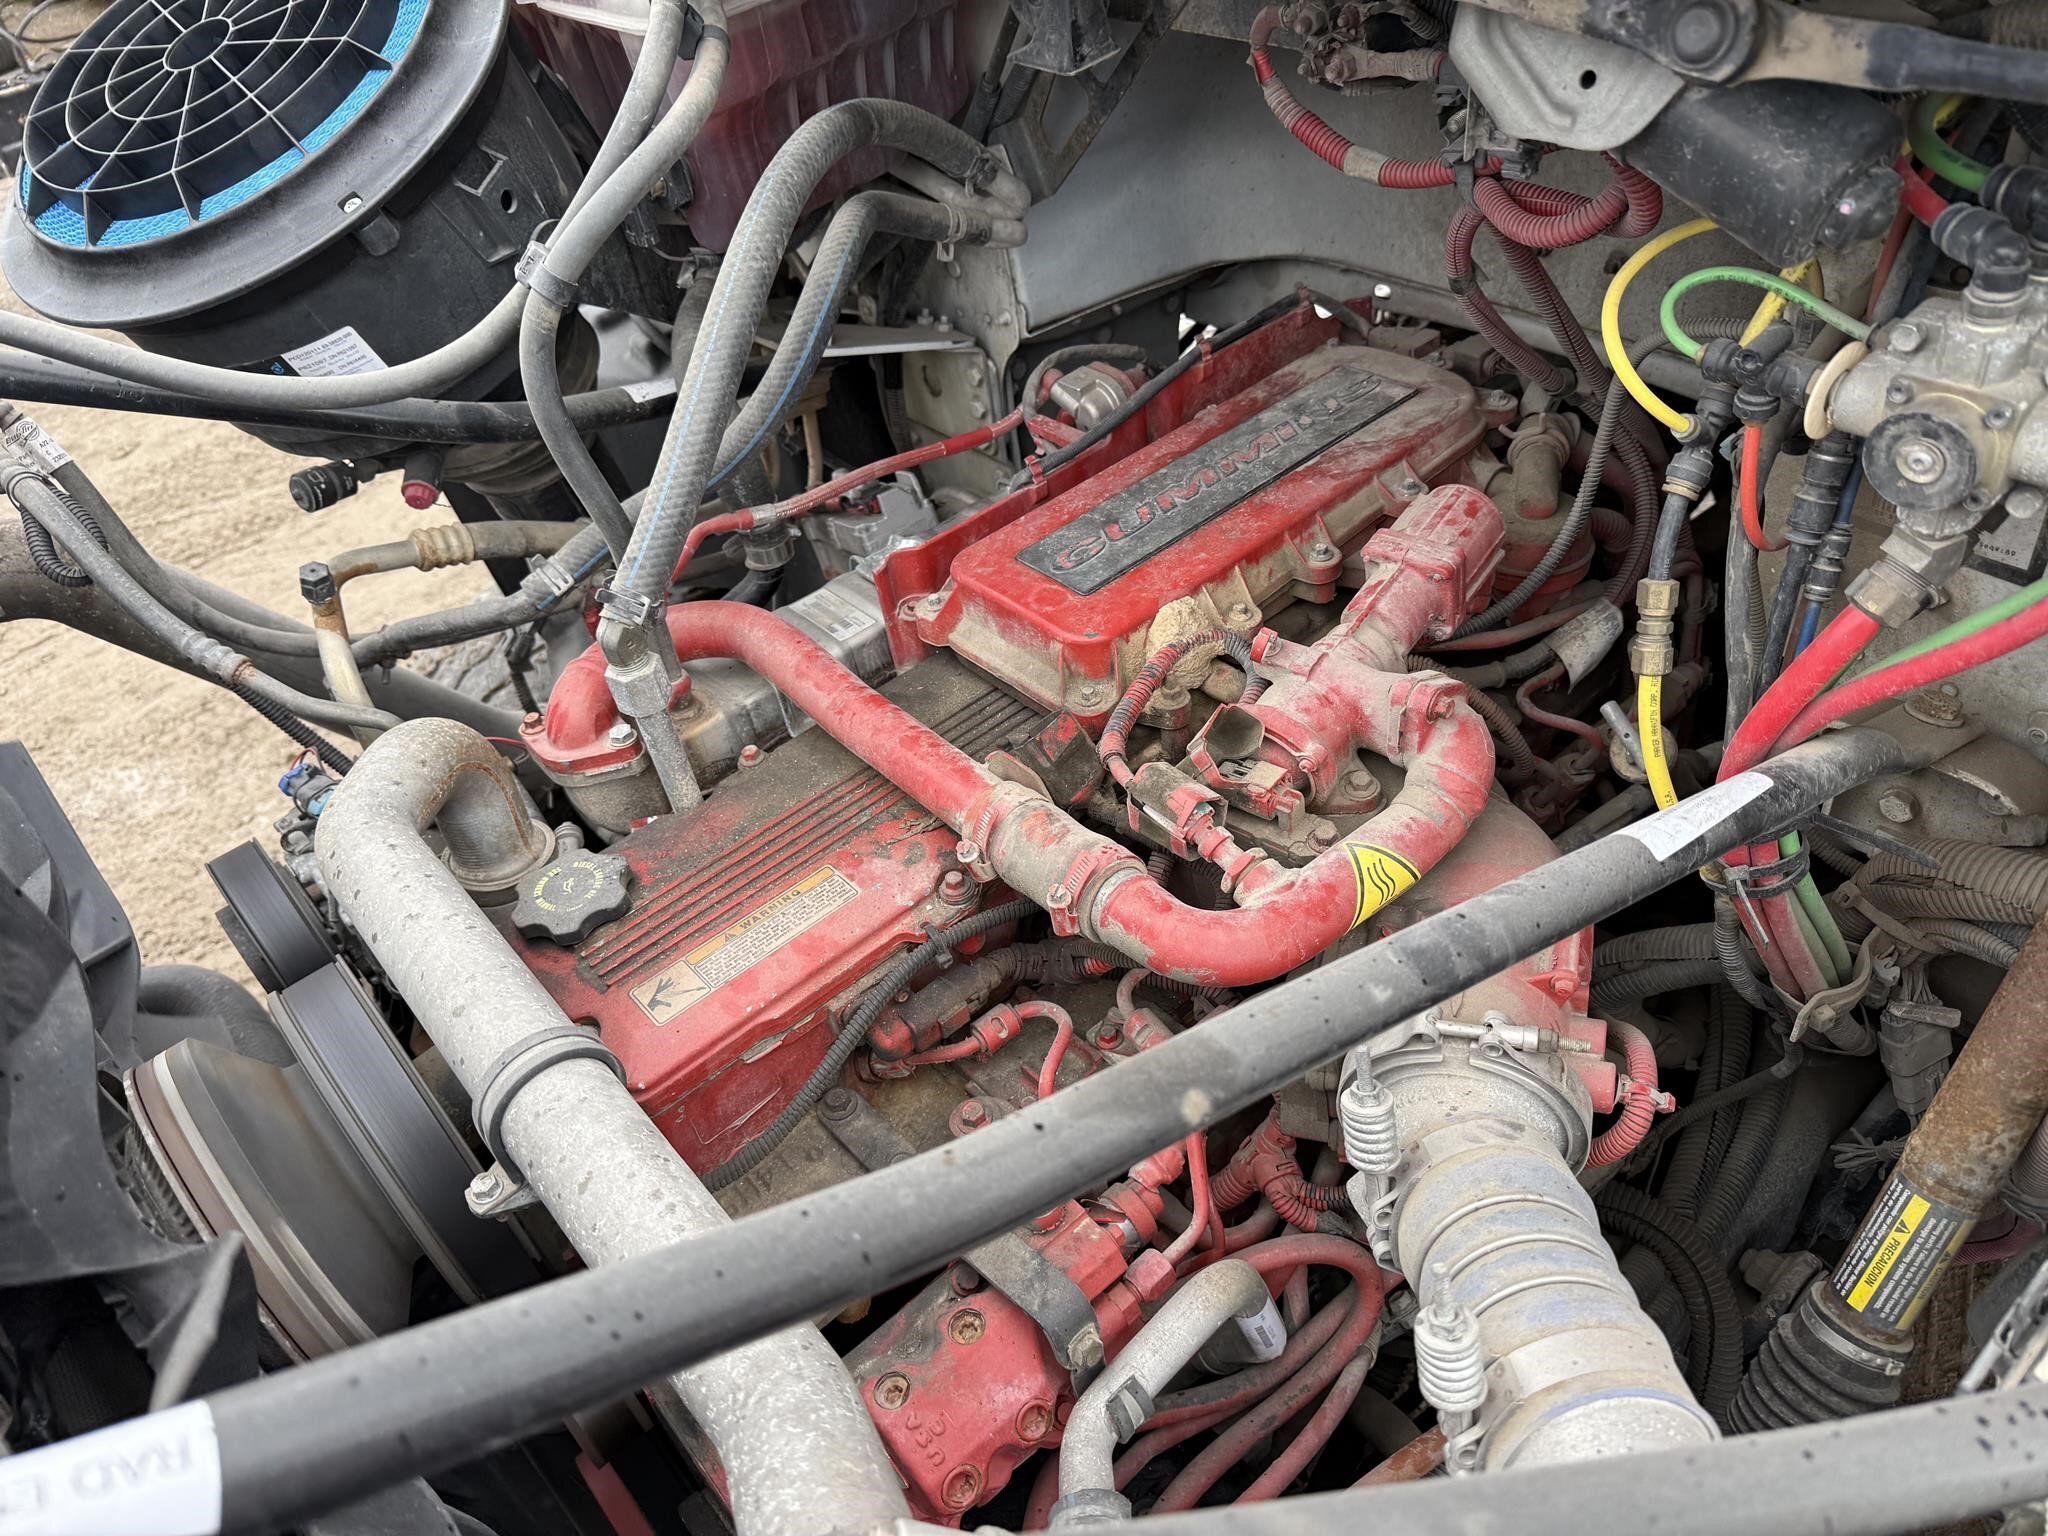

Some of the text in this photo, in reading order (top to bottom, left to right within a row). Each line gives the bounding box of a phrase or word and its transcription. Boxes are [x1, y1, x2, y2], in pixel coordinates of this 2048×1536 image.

[1050, 373, 1383, 574] CUMMINS
[739, 887, 801, 931] WARNING
[1889, 1188, 1910, 1218] Componente
[1884, 1215, 1894, 1225] con
[1920, 1216, 1935, 1238] damage
[1863, 1236, 1900, 1287] PRECAUCION
[1903, 1242, 1919, 1264] steering
[1913, 1248, 1926, 1267] Failure
[1892, 1262, 1906, 1281] system
[1918, 1265, 1941, 1300] CAUTION
[1873, 1279, 1895, 1311] components.
[1891, 1284, 1904, 1299] could
